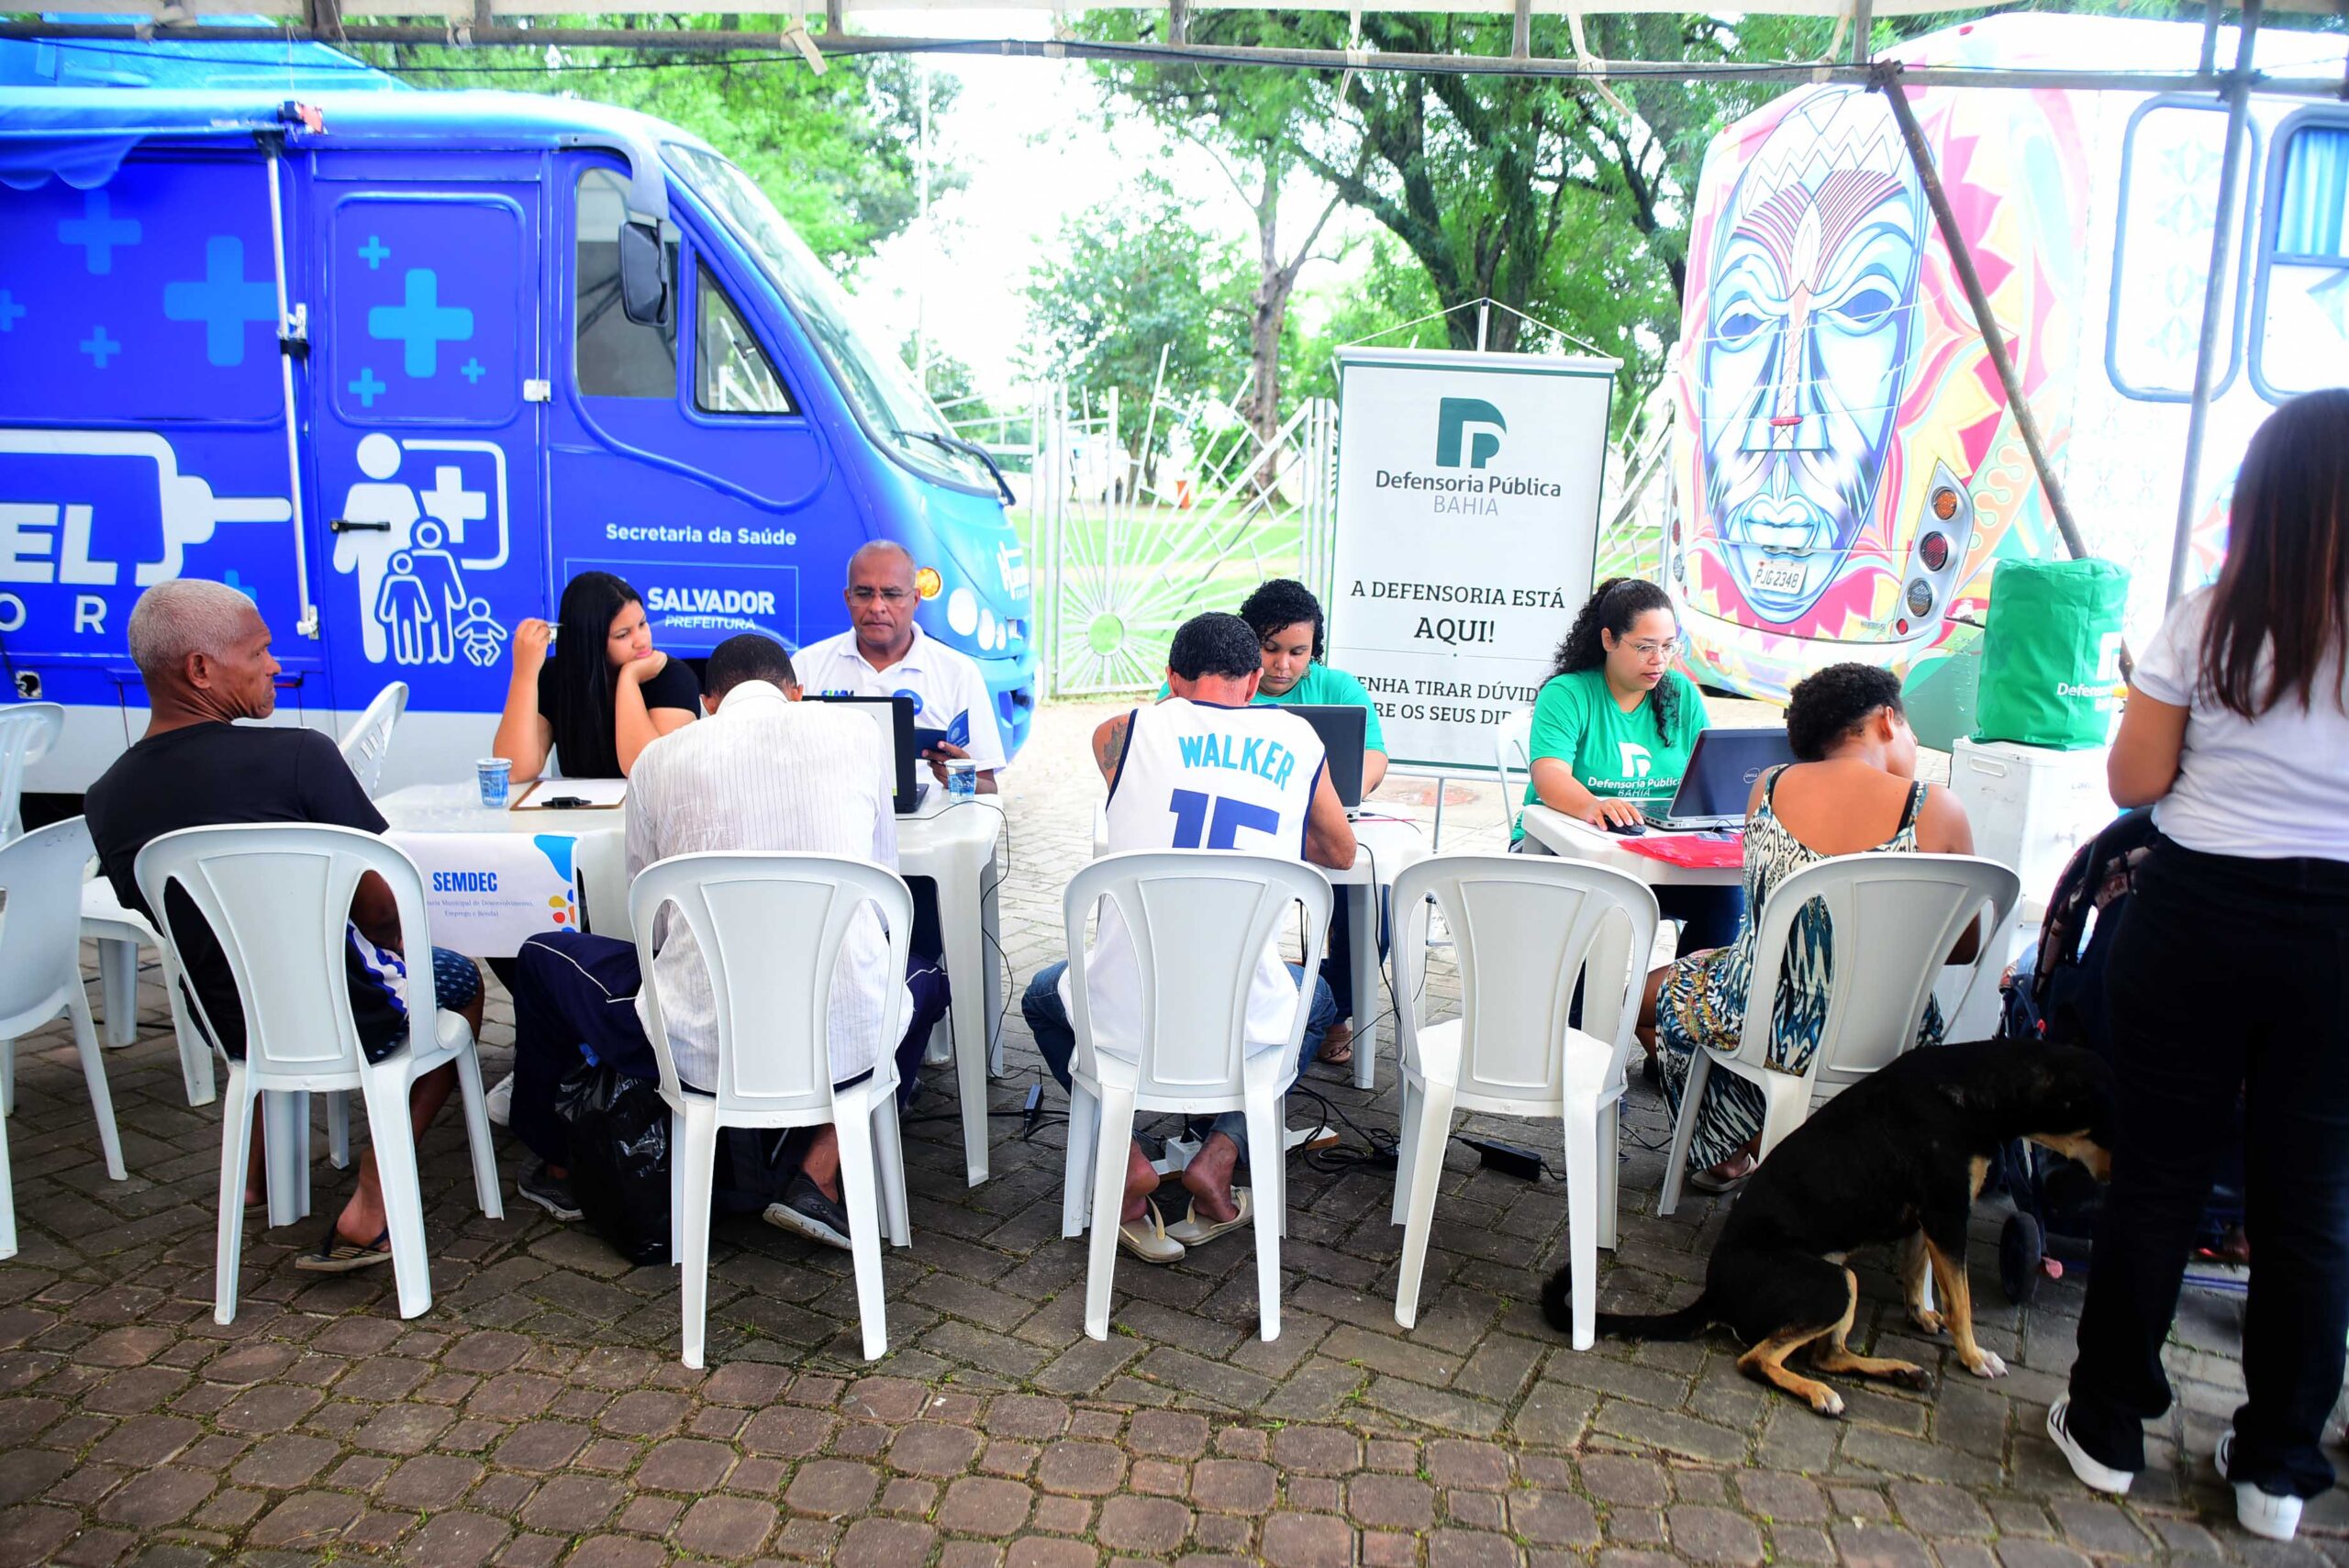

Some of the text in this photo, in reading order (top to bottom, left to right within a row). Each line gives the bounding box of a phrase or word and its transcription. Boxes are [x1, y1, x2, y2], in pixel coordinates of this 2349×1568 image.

[1375, 470, 1562, 497] Defensoria Pública
[1433, 495, 1498, 516] BAHIA
[606, 523, 797, 546] Secretaria da Saúde
[647, 586, 776, 615] SALVADOR
[1351, 580, 1566, 608] A DEFENSORIA ESTÁ
[664, 614, 756, 630] PREFEITURA
[1414, 617, 1495, 646] AQUI!
[1353, 675, 1539, 703] ENHA TIRAR DÚVID
[1400, 704, 1424, 720] OS
[1430, 706, 1476, 723] SEUS
[1177, 732, 1295, 792] WALKER
[1587, 776, 1645, 789] Defensoria
[1618, 789, 1651, 797] BAHIA
[432, 872, 498, 893] SEMDEC
